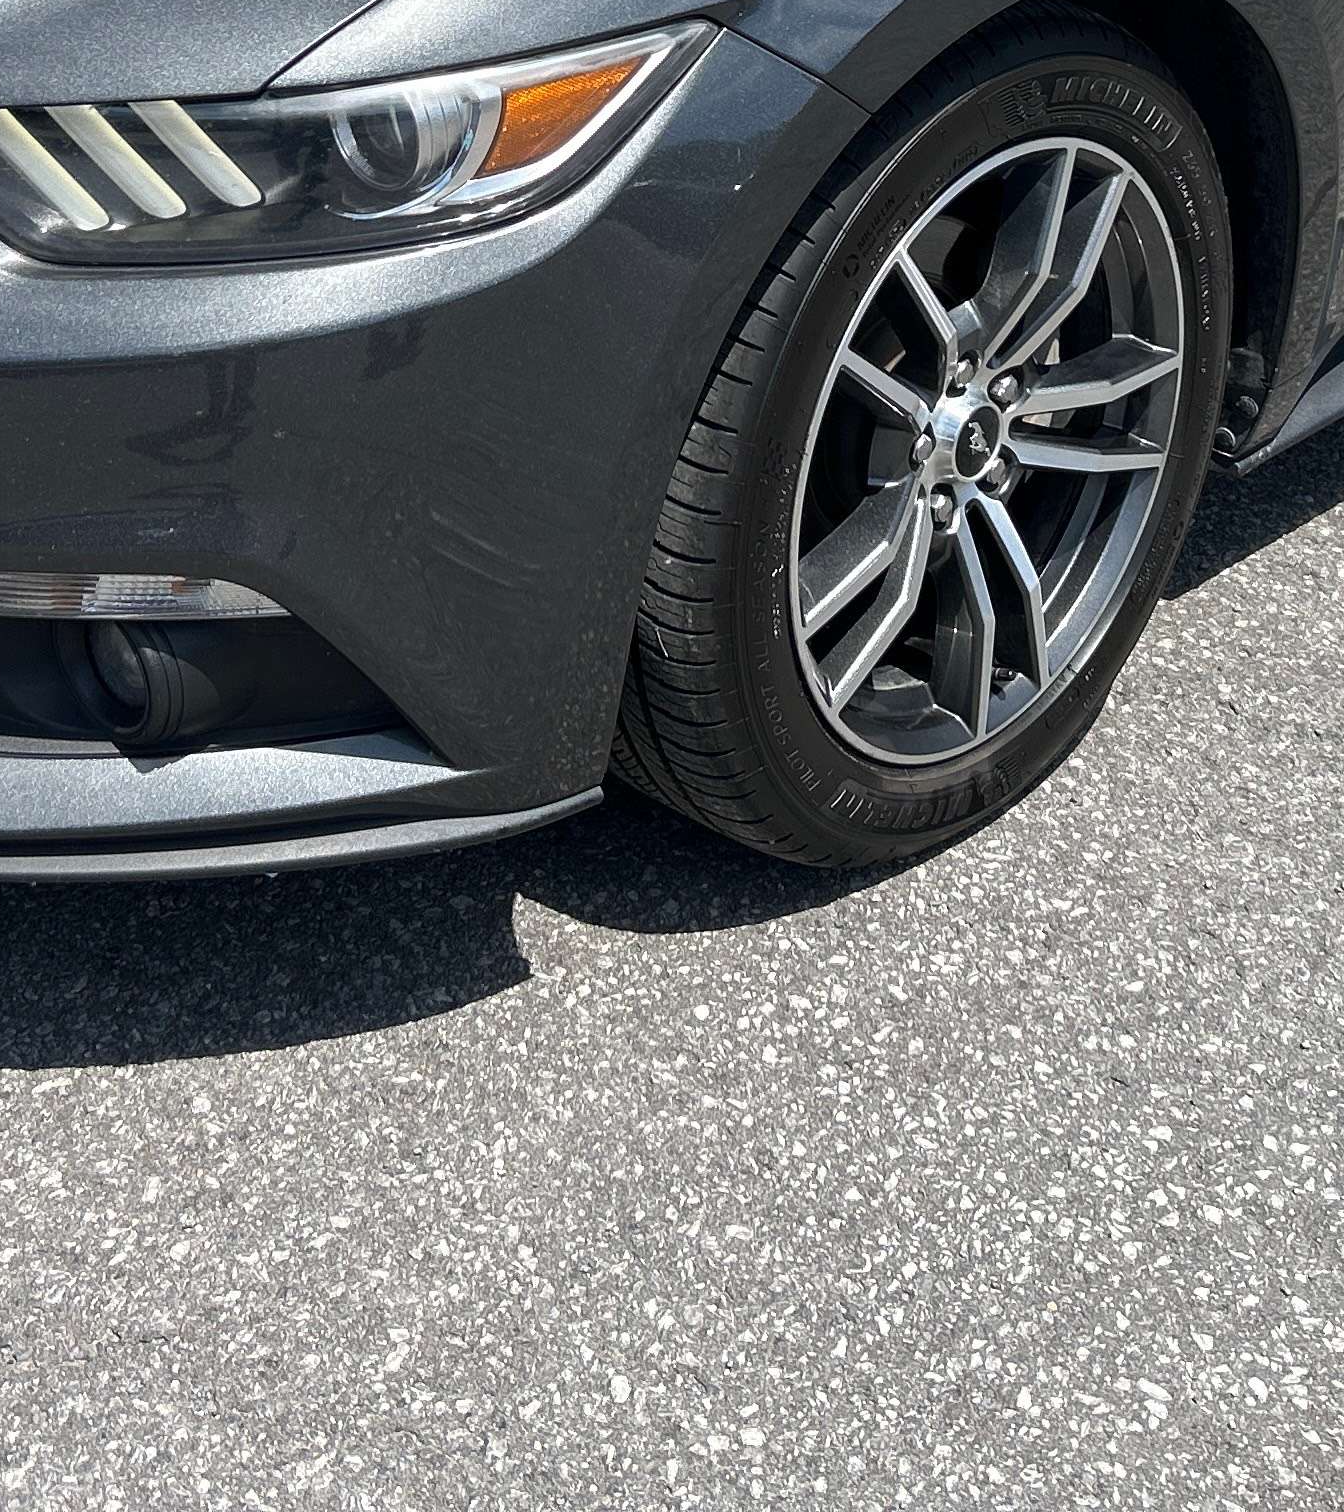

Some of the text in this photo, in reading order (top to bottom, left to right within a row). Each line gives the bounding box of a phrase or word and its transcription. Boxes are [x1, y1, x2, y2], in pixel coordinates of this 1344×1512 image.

[1051, 76, 1174, 135] MICHELIN
[755, 637, 772, 672] ALL
[759, 685, 792, 746] SPORT
[784, 749, 823, 792] PILOT
